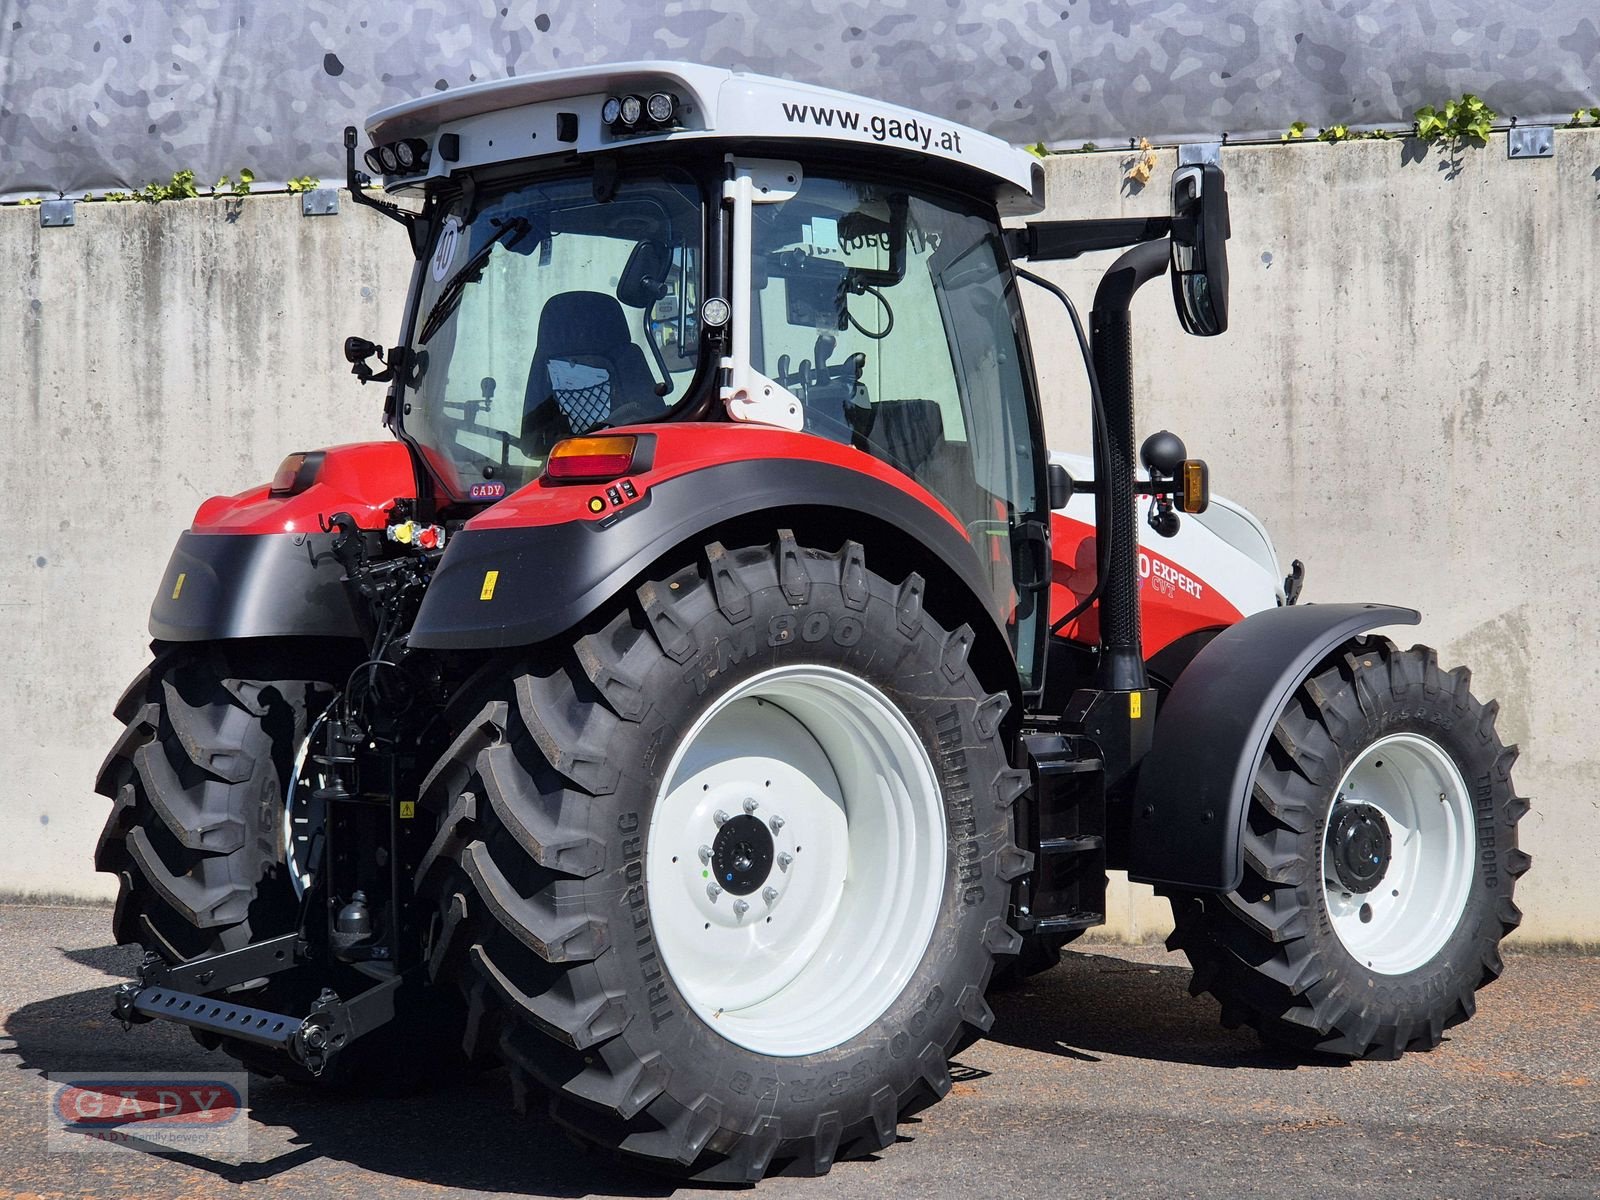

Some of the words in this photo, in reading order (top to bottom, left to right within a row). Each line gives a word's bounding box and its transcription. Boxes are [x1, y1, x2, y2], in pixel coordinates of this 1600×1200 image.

[782, 103, 962, 154] www.gady.at
[436, 230, 454, 270] 40
[472, 485, 501, 496] GADY
[1151, 575, 1176, 599] CVT
[1152, 559, 1203, 600] EXPERT
[768, 611, 863, 647] 800
[935, 703, 985, 907] TRELLEBORG
[1477, 771, 1499, 889] TRELLEBORG
[617, 812, 674, 1034] TRELLEBORG
